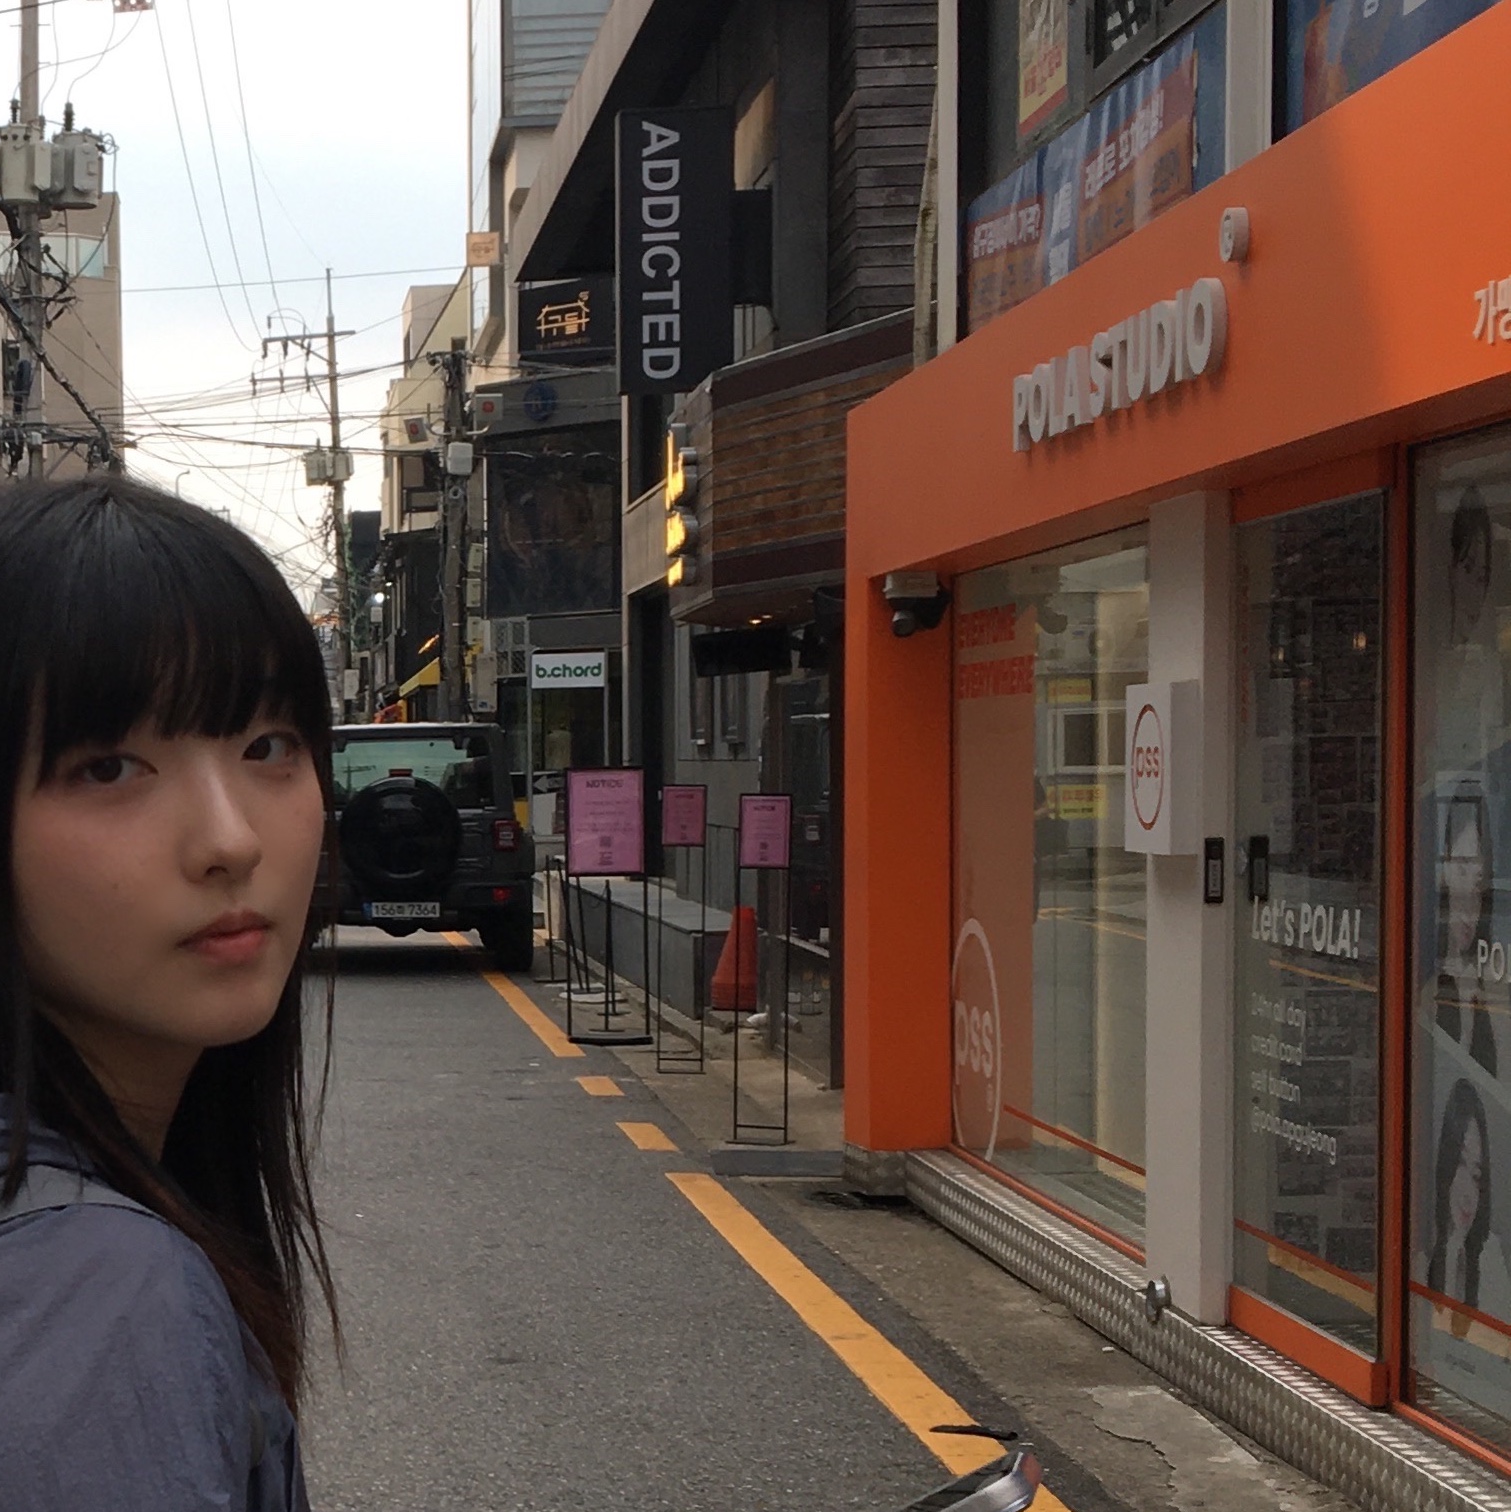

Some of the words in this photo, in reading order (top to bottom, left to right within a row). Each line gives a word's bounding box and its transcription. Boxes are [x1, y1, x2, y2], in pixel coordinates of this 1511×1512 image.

[641, 120, 681, 381] ADDICTED
[1013, 346, 1095, 452] POLA
[1090, 278, 1228, 418] STUDIO
[535, 662, 602, 679] b.chord
[958, 654, 1035, 699] EVERYWHERE
[586, 780, 624, 789] NOTICE
[1134, 746, 1159, 789] pss
[1251, 895, 1295, 947] Let's
[1298, 902, 1361, 960] POLA!
